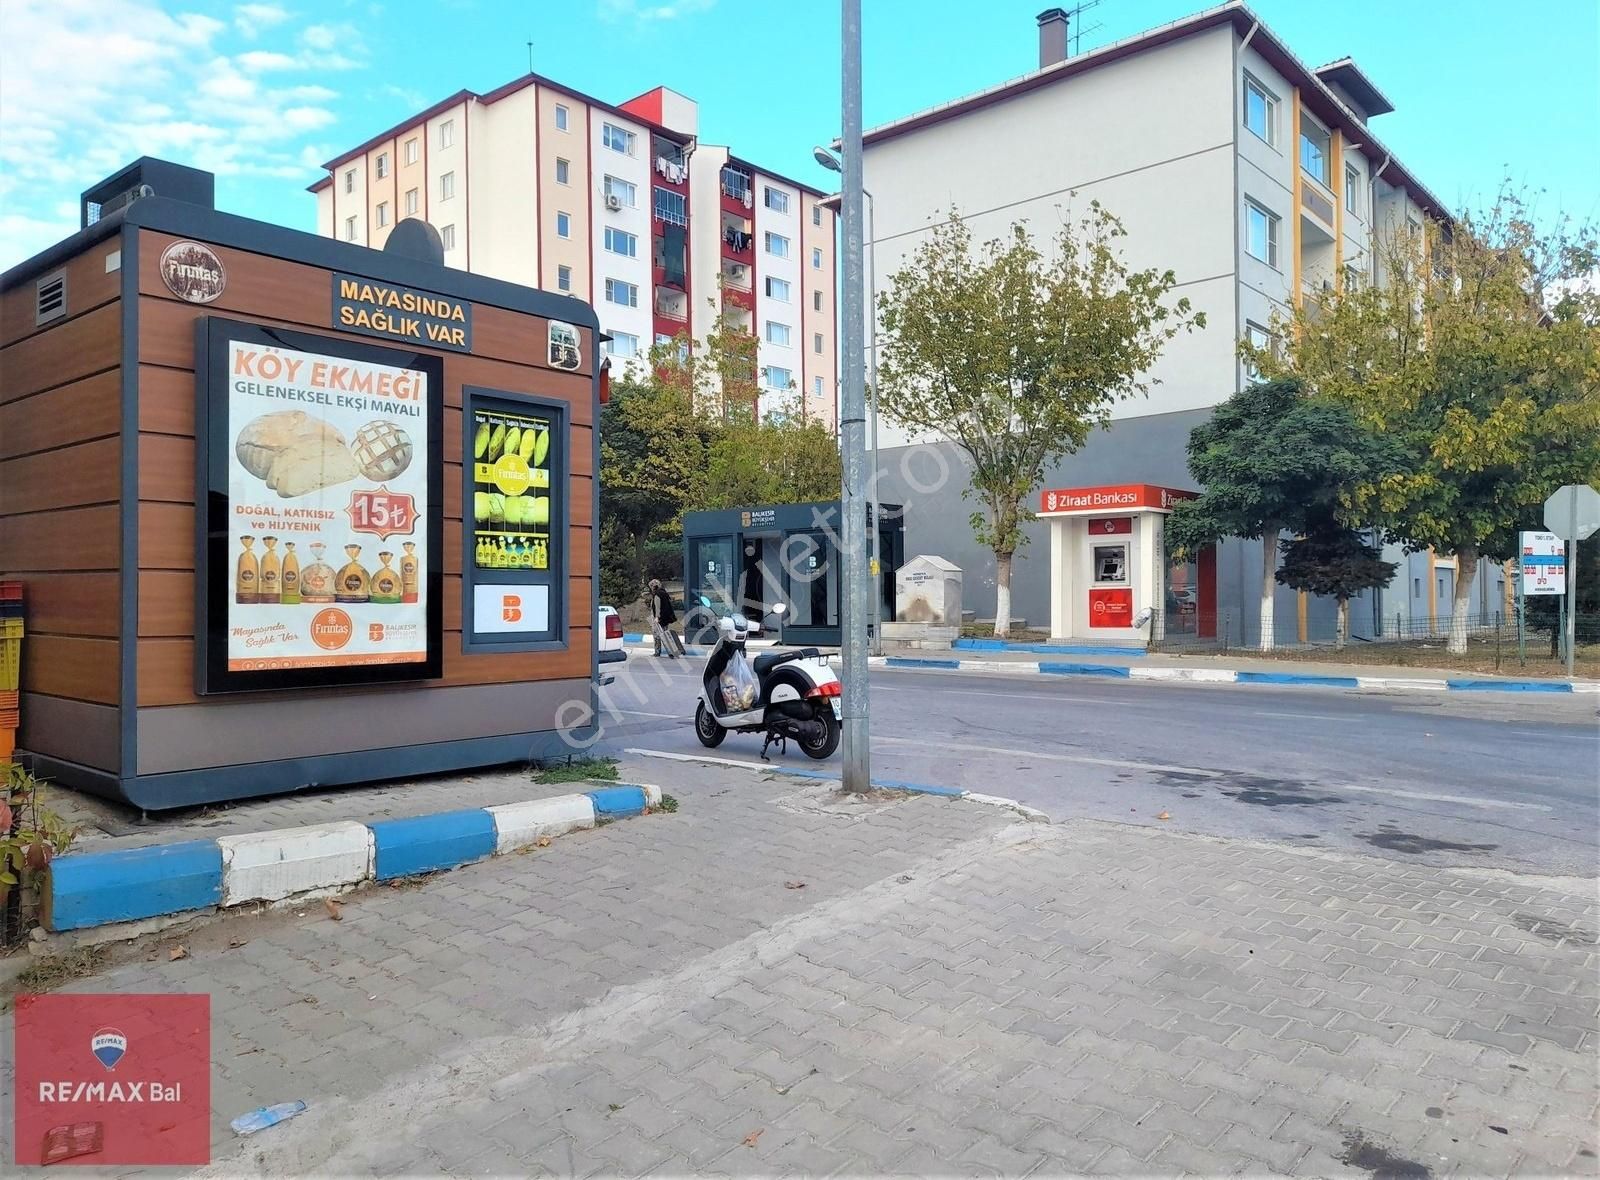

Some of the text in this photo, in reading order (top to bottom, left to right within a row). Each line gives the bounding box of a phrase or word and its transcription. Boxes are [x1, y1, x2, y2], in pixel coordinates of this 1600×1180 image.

[340, 279, 466, 323] MAYASINDA
[340, 306, 466, 347] SAĞLIK VAR
[234, 348, 422, 401] KÖY EKMEĞİ
[234, 381, 420, 417] GELENEKSEL EKŞİ MAYALI
[1059, 492, 1138, 507] Ziraat Bankası
[235, 503, 336, 520] DOĞAL, KATKISIZ
[251, 521, 265, 530] ve
[231, 622, 286, 638] Mayasında
[245, 634, 275, 648] Sağlık
